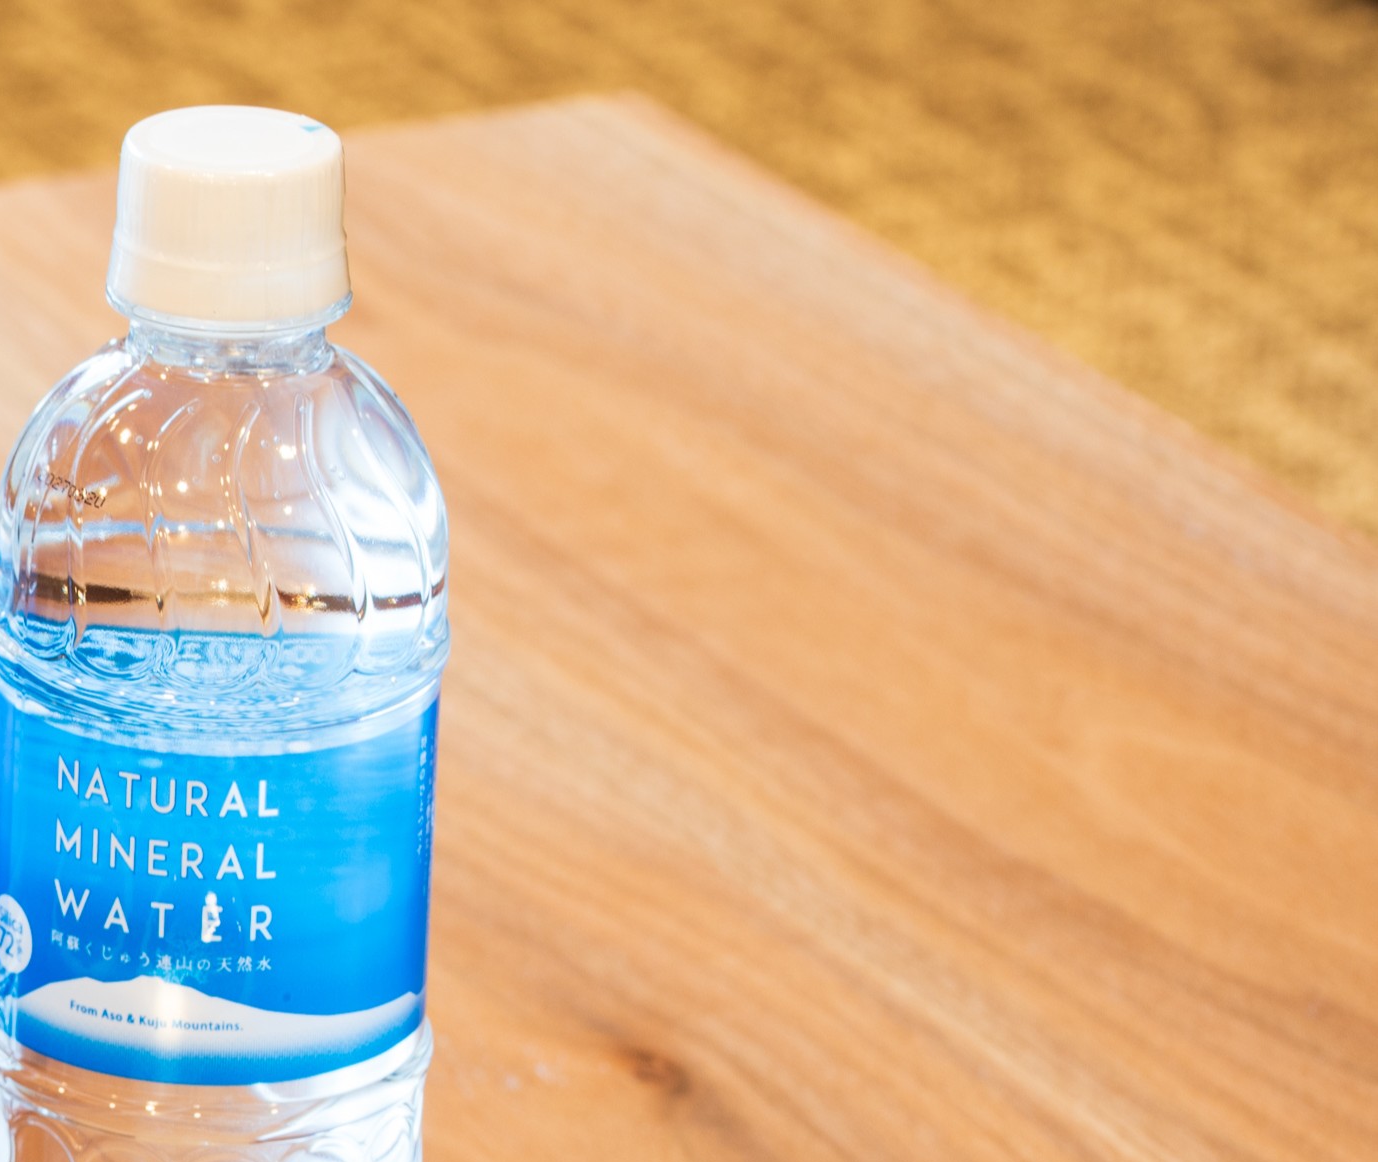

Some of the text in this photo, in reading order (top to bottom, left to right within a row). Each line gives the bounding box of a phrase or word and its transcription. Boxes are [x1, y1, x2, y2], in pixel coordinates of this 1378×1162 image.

[57, 754, 280, 818] NATURAL
[55, 817, 277, 881] MINERAL
[53, 878, 274, 943] WATER
[0, 924, 14, 957] 72
[50, 928, 272, 973] 阿蘇くじゅう連山の天然水
[70, 1000, 98, 1017] From
[101, 1008, 123, 1023] Aso
[127, 1013, 135, 1025] &
